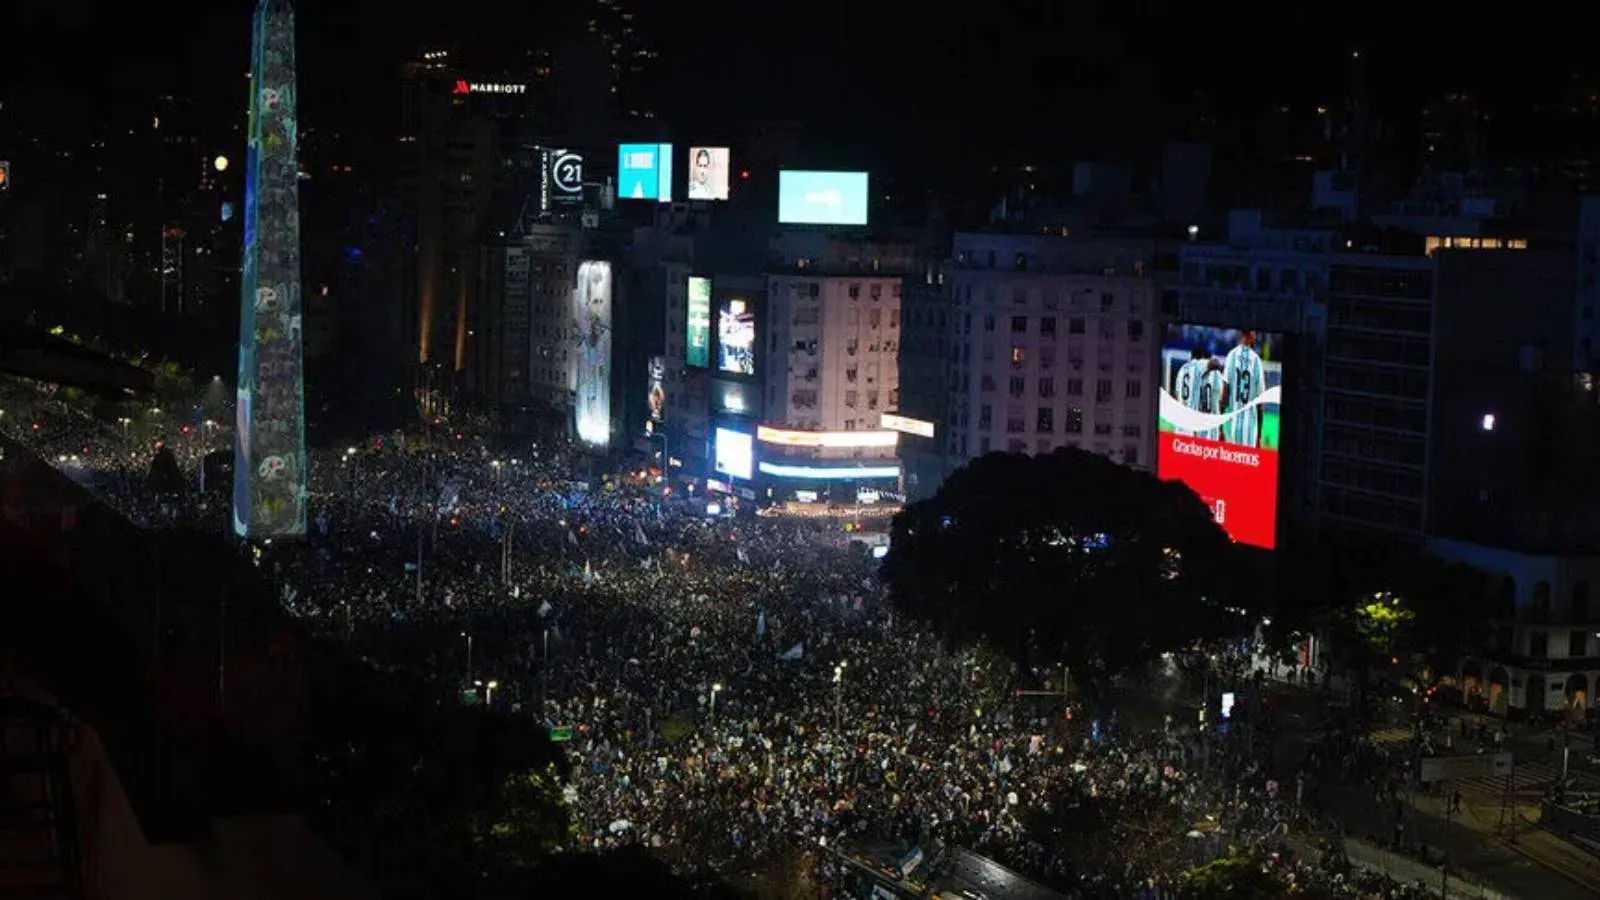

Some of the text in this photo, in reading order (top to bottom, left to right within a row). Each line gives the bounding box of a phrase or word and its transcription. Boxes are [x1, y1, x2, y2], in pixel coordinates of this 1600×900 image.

[470, 83, 526, 94] MARRIOTT
[1236, 368, 1250, 403] 13
[1173, 438, 1202, 456] Gracias
[1203, 446, 1220, 460] por
